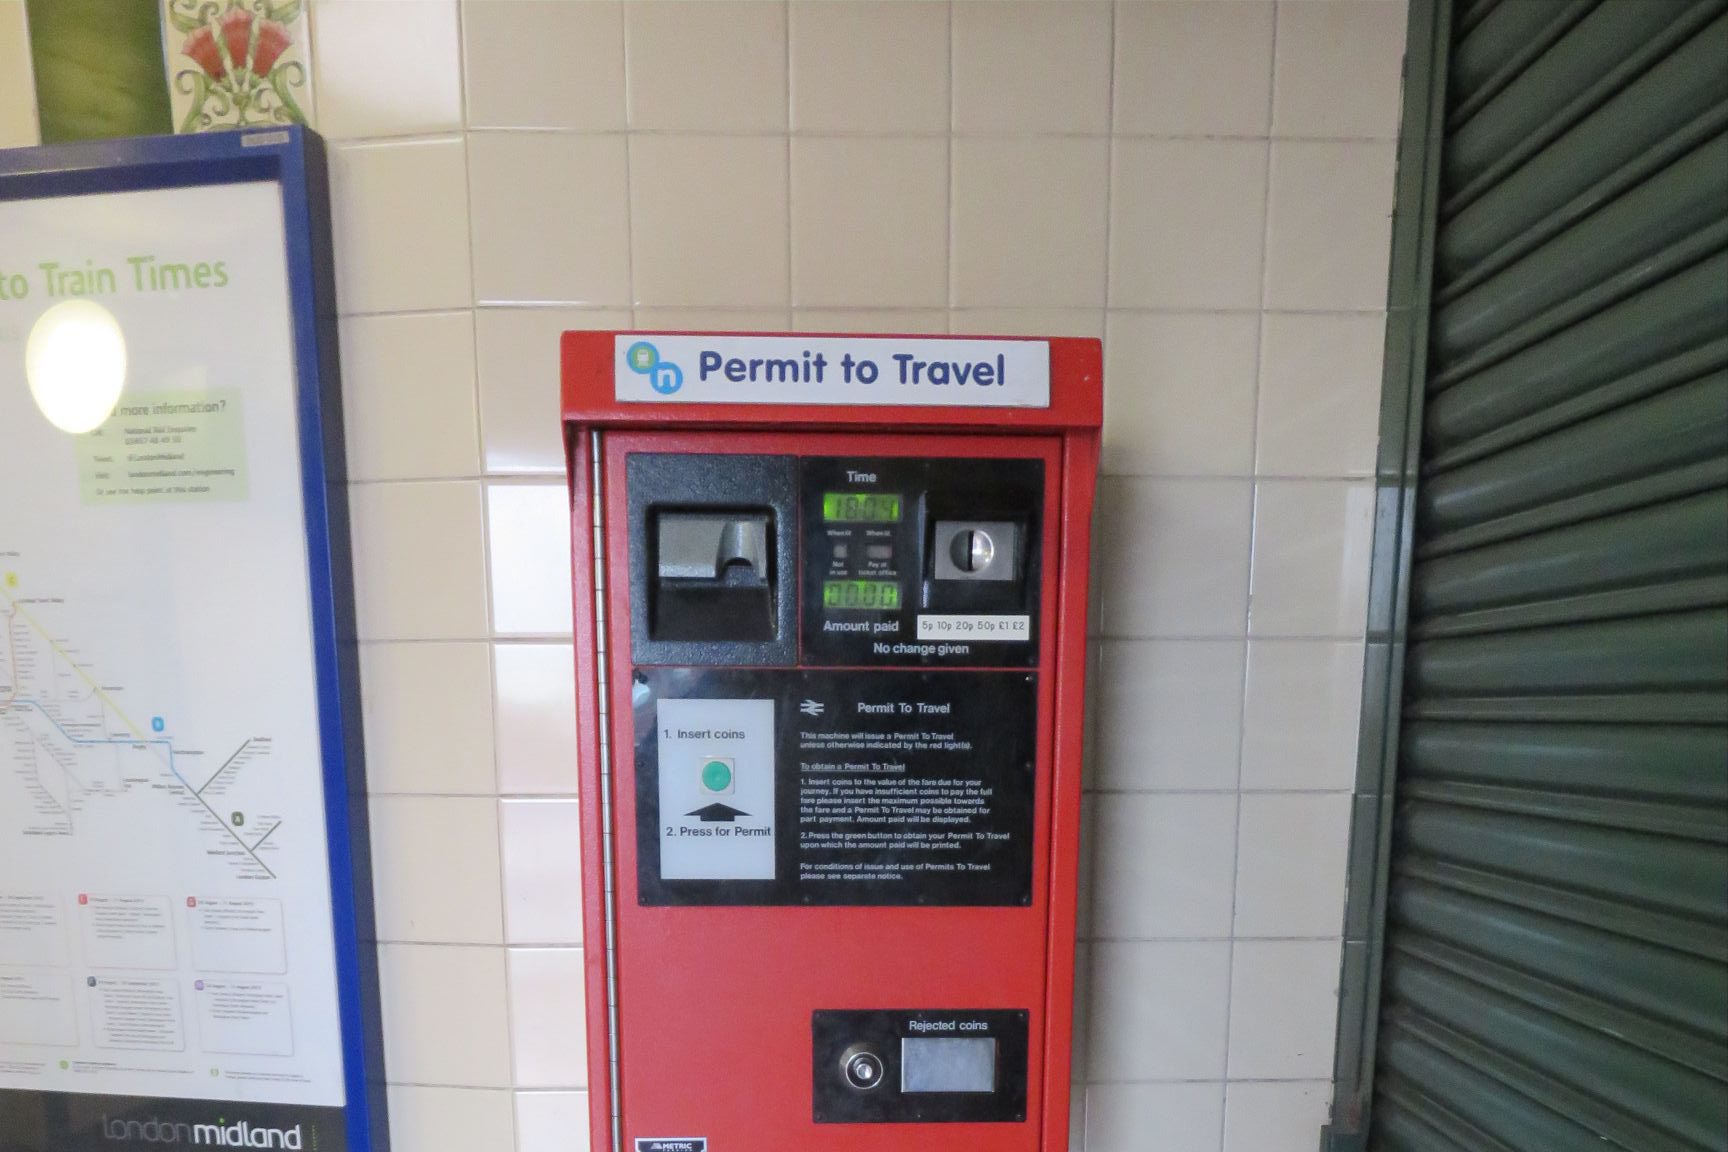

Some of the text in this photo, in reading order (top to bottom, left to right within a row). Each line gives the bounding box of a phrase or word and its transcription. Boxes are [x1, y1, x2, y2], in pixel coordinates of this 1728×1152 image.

[38, 259, 117, 296] Train
[127, 255, 229, 292] Times
[700, 350, 1004, 386] Permit to Travel
[120, 406, 148, 416] more
[152, 400, 226, 415] information?
[847, 470, 877, 483] Time
[823, 620, 899, 634] Amount paid
[922, 621, 1025, 632] 5p 10p 20p 50p £1 £2
[873, 643, 969, 656] No change given
[857, 703, 951, 714] Permit To Travel
[664, 729, 745, 739] 1. Insert coins
[904, 742, 913, 750] by
[800, 788, 832, 796] journey.
[666, 826, 771, 836] 2. Press for Permit
[845, 832, 867, 840] green
[928, 832, 945, 840] your
[889, 842, 905, 850] paid
[932, 842, 962, 850] printed.
[909, 1020, 988, 1032] Rejected coins
